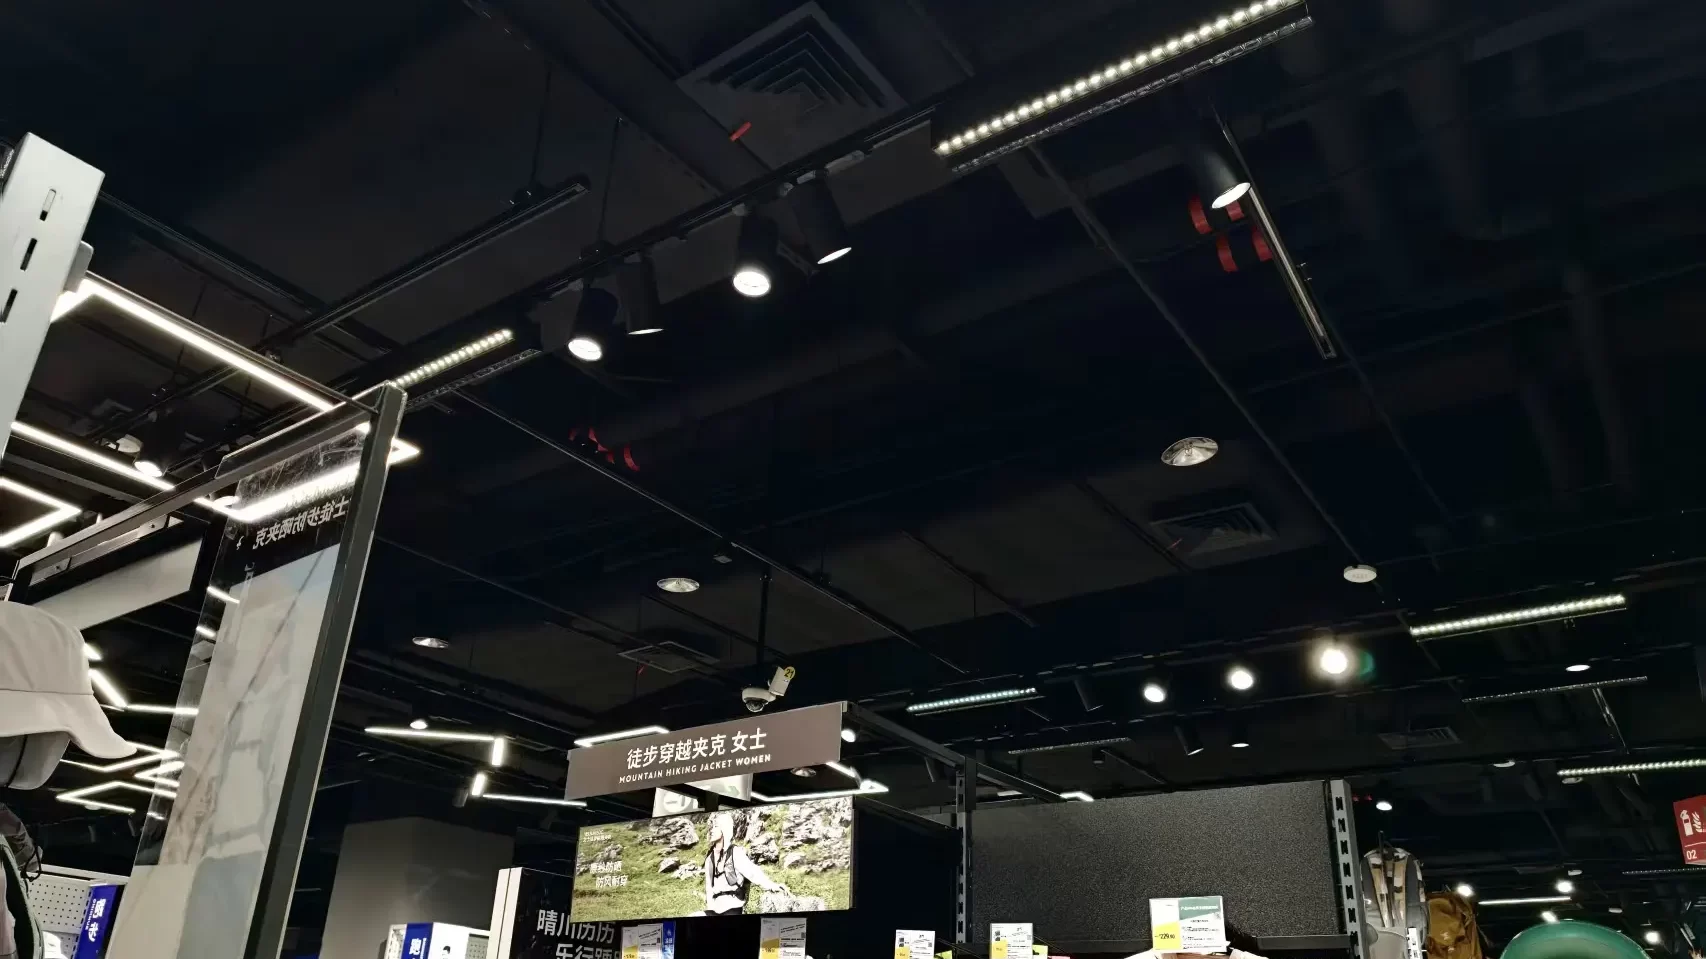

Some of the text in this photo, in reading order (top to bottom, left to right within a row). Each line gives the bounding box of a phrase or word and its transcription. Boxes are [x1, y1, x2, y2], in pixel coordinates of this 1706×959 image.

[626, 727, 767, 769] 徒步穿越夹克 女士
[619, 753, 771, 784] MOUNTAIN HIKING JACKET WOMEN
[1686, 849, 1697, 860] 02
